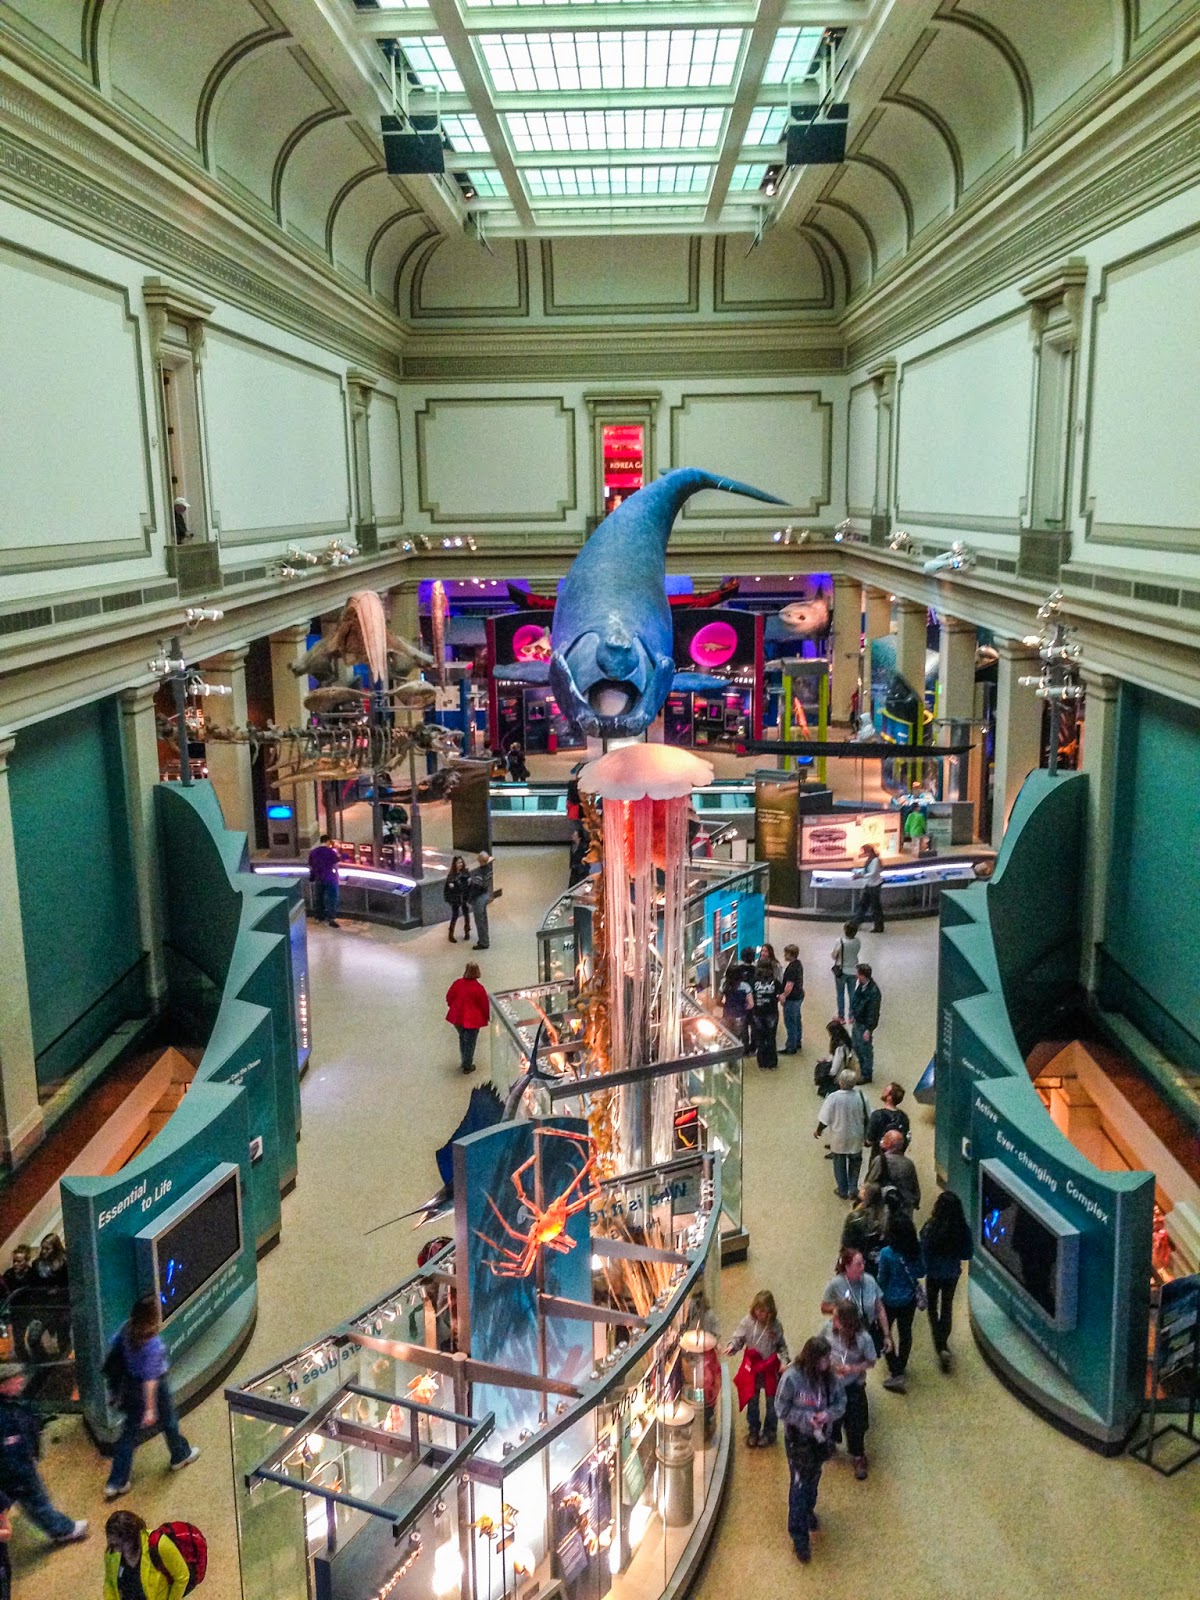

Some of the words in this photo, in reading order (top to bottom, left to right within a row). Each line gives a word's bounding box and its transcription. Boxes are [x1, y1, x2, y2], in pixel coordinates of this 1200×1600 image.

[610, 461, 634, 469] KOREA
[975, 1097, 998, 1123] Active
[1065, 1179, 1108, 1224] Complex
[98, 1179, 147, 1230] Essential
[141, 1196, 152, 1212] to
[154, 1180, 172, 1202] Life
